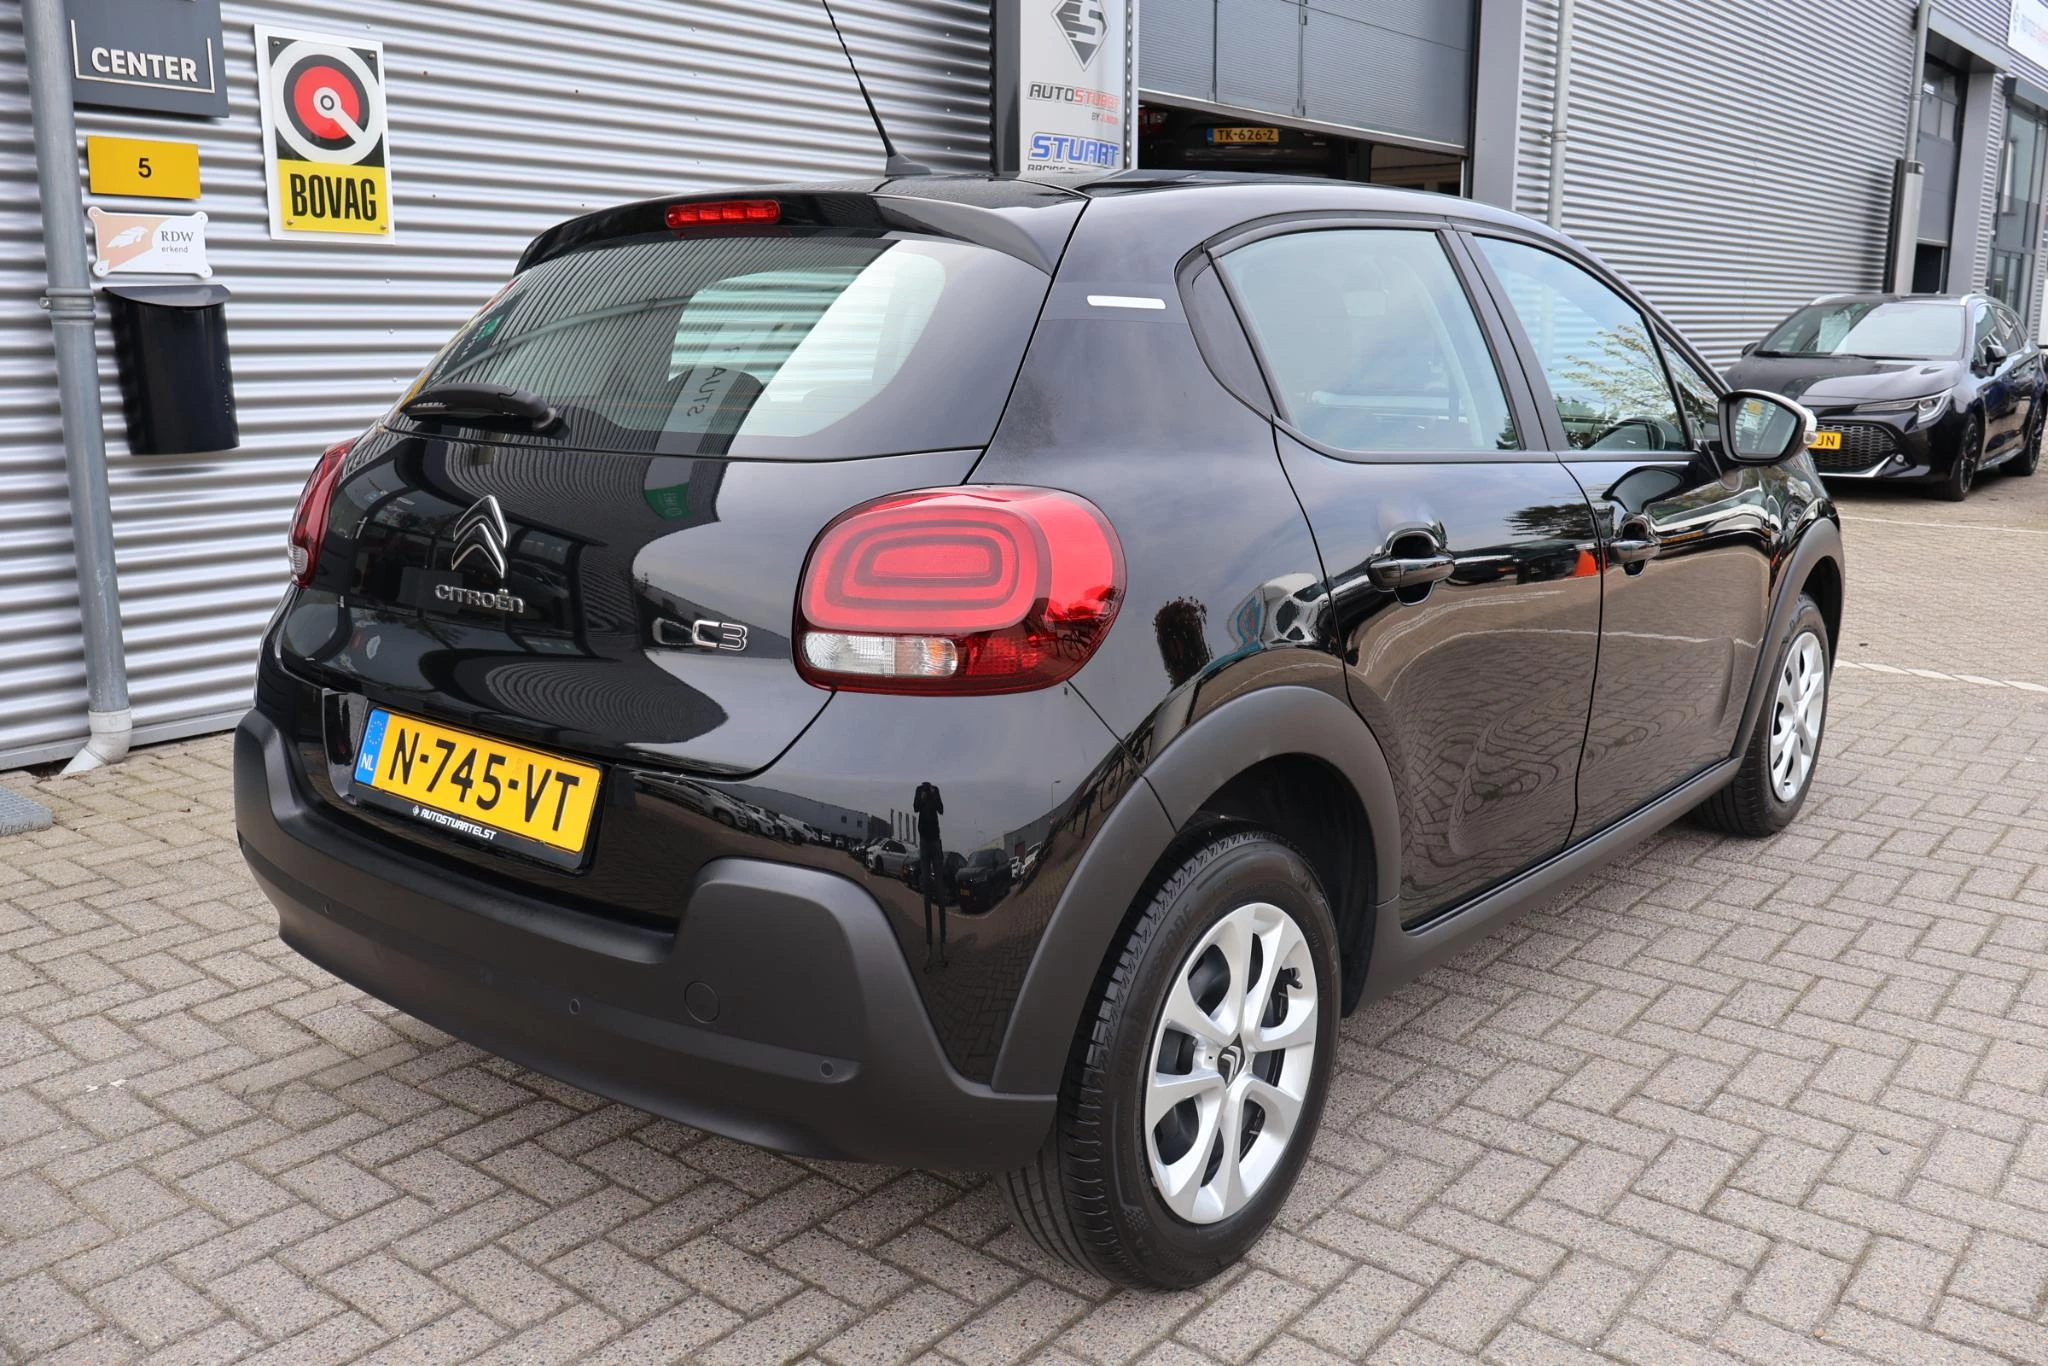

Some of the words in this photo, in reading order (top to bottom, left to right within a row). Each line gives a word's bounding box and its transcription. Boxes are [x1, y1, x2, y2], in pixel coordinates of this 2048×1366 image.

[91, 46, 198, 83] CENTER
[1030, 134, 1120, 167] STUART
[1216, 129, 1274, 141] TK-626-Z
[137, 157, 152, 179] 5
[290, 173, 377, 221] BOVAG
[160, 230, 194, 242] RDW
[161, 245, 189, 254] erkend
[690, 619, 748, 651] C3
[360, 752, 374, 773] NL
[388, 727, 581, 832] N-745-VT
[420, 807, 497, 840] AUTOSTUARTELST
